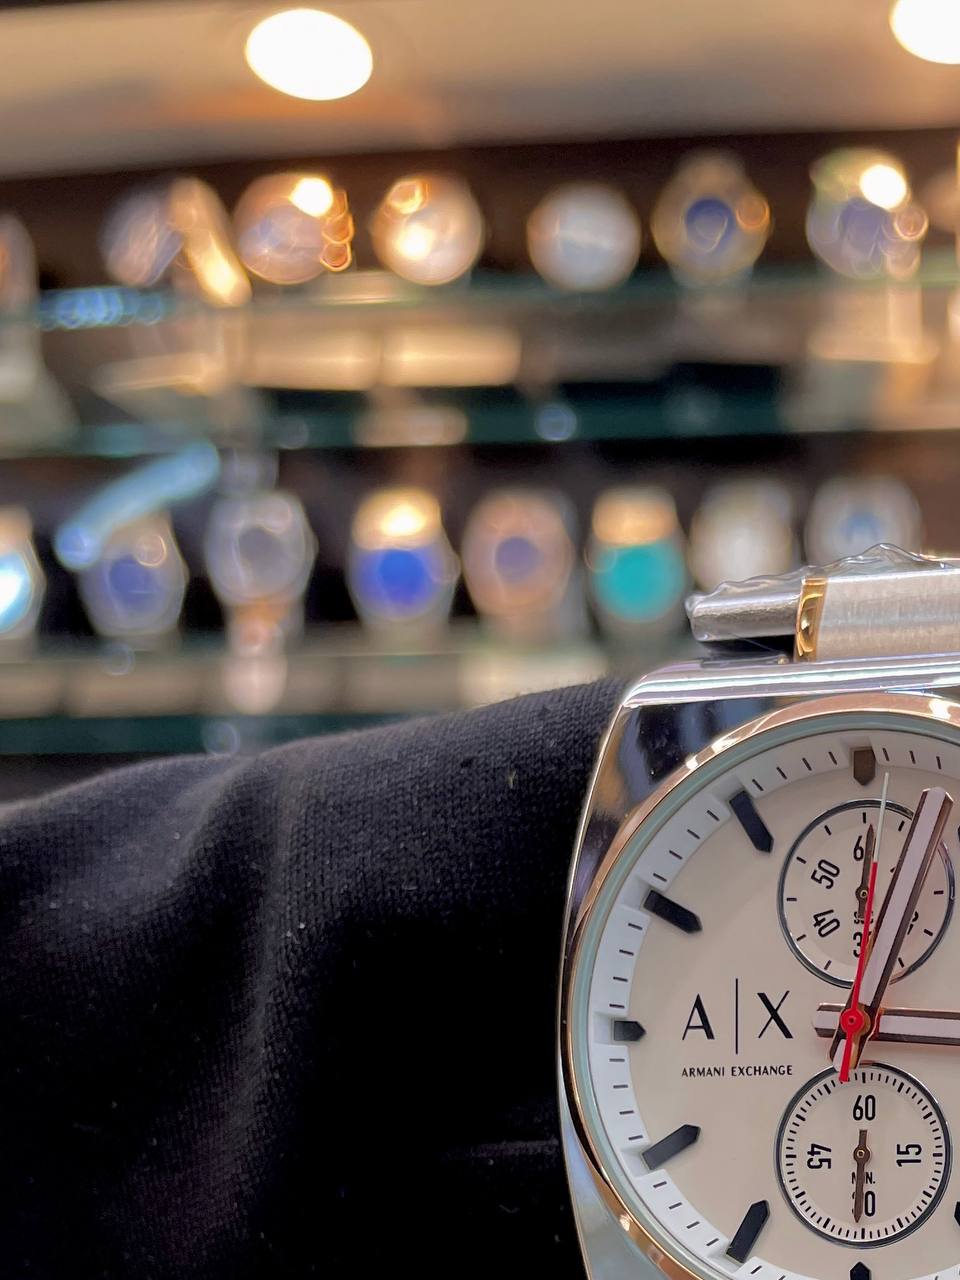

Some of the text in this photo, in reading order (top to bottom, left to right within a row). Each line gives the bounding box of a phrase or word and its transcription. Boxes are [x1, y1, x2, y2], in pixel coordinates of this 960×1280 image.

[811, 859, 840, 889] 50
[813, 909, 840, 938] 40
[681, 1064, 793, 1078] ARMANI EXCHANGE
[853, 1094, 876, 1121] 60
[806, 1143, 832, 1170] 45
[896, 1143, 922, 1168] 15
[852, 1190, 876, 1217] 0
